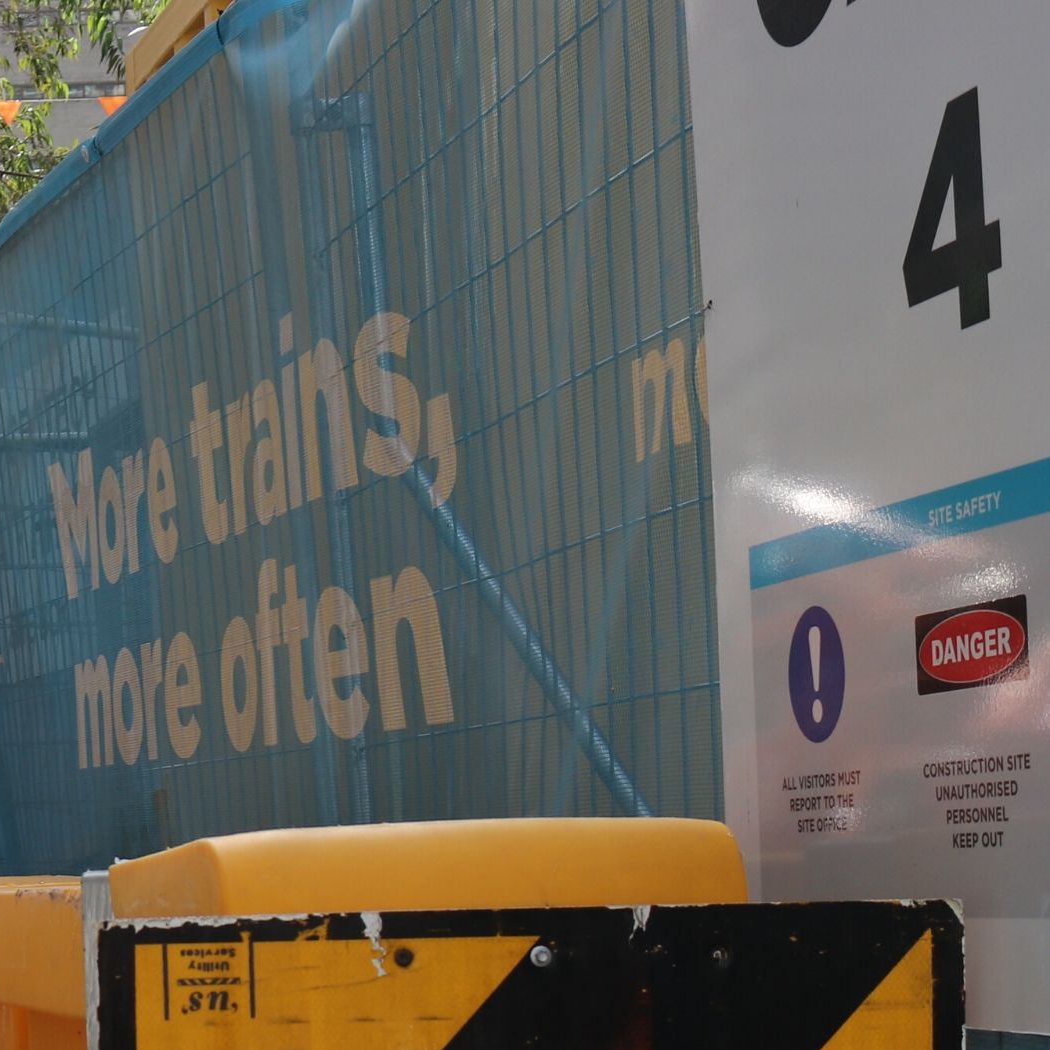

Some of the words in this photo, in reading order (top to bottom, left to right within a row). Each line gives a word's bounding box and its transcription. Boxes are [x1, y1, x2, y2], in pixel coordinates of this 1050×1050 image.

[902, 85, 1003, 331] 4
[48, 436, 179, 600] More
[190, 311, 457, 546] trains,
[928, 504, 953, 528] SITE
[955, 490, 1002, 520] SAFETY
[931, 626, 1012, 667] DANGER
[74, 630, 202, 769] more
[221, 558, 455, 752] often
[923, 756, 1004, 778] CONSTRUCTION
[1007, 753, 1031, 771] SITE
[782, 776, 797, 791] ALL
[798, 773, 836, 789] VISITORS
[837, 770, 861, 786] MUST
[935, 780, 1018, 801] UNAUTHORISED
[790, 796, 821, 812] REPORT
[823, 795, 835, 808] TO
[837, 793, 854, 808] THE
[797, 818, 815, 833] SITE
[946, 806, 1009, 825] PERSONNEL
[952, 832, 979, 849] KEEP
[981, 831, 1004, 848] OUT
[180, 948, 236, 958] Services
[188, 960, 230, 972] Utility
